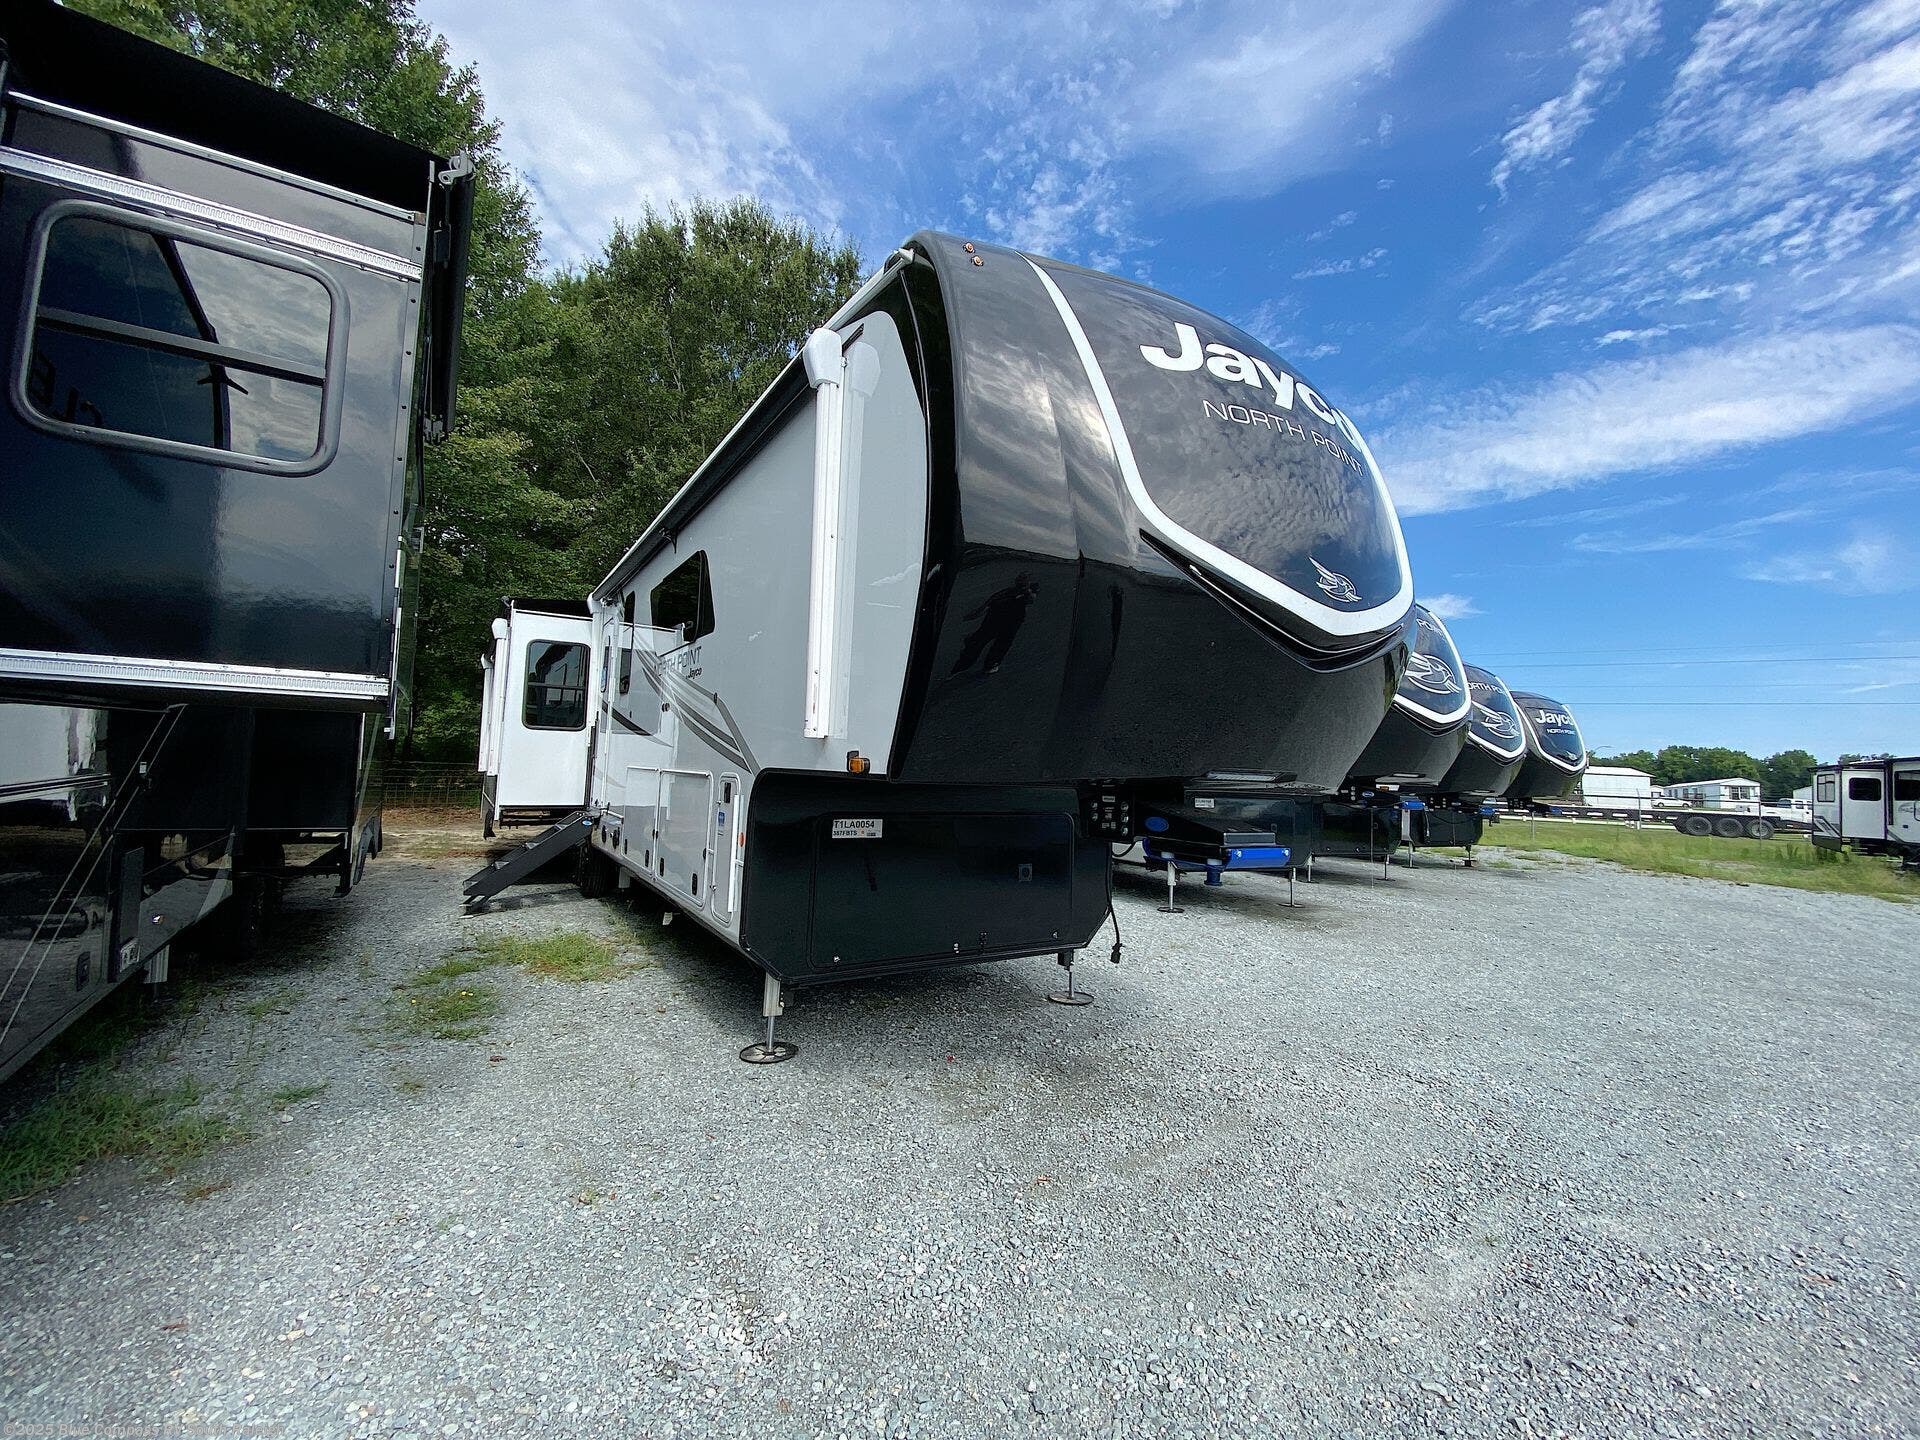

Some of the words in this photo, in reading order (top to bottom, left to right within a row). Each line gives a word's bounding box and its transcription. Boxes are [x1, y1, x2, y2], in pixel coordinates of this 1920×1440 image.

[1139, 321, 1363, 453] Jayco
[1202, 400, 1306, 441] NORTH
[1311, 430, 1365, 477] POINT
[1466, 682, 1492, 692] ORTH
[834, 820, 875, 829] T1LA0054
